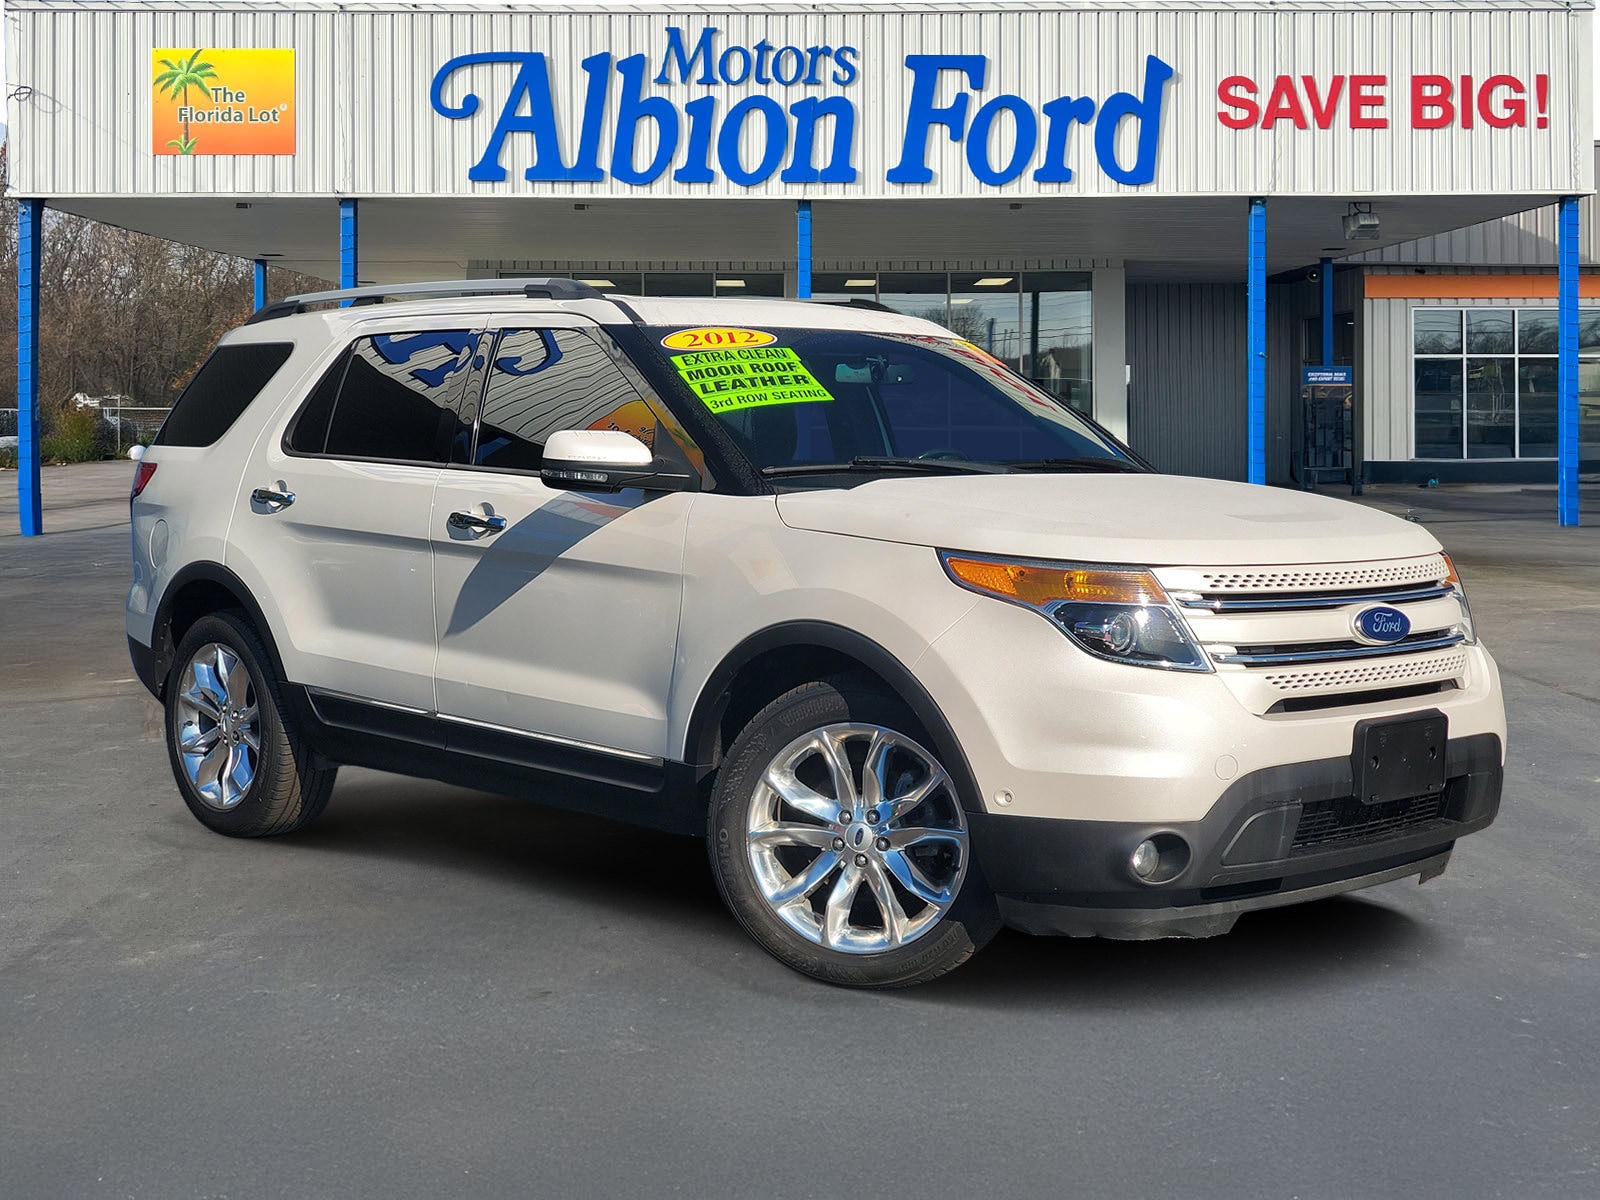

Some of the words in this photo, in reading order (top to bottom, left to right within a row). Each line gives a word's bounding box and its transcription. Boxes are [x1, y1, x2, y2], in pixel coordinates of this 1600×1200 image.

[653, 27, 857, 86] Motors
[211, 86, 246, 103] The
[1217, 75, 1388, 129] SAVE
[1411, 74, 1548, 129] BIG!
[177, 106, 243, 123] Florida
[248, 106, 279, 123] Lot
[430, 52, 856, 186] Albion
[886, 54, 1173, 186] Ford
[683, 331, 758, 347] 2012
[681, 351, 735, 366] EXTRA
[739, 349, 785, 360] CLEAN
[686, 365, 744, 381] MOON
[751, 362, 797, 374] ROOF
[700, 374, 810, 395] LEATHER
[710, 397, 733, 409] 3rd
[737, 393, 768, 404] ROW
[772, 389, 827, 400] SEATING
[1373, 612, 1402, 632] Ford
